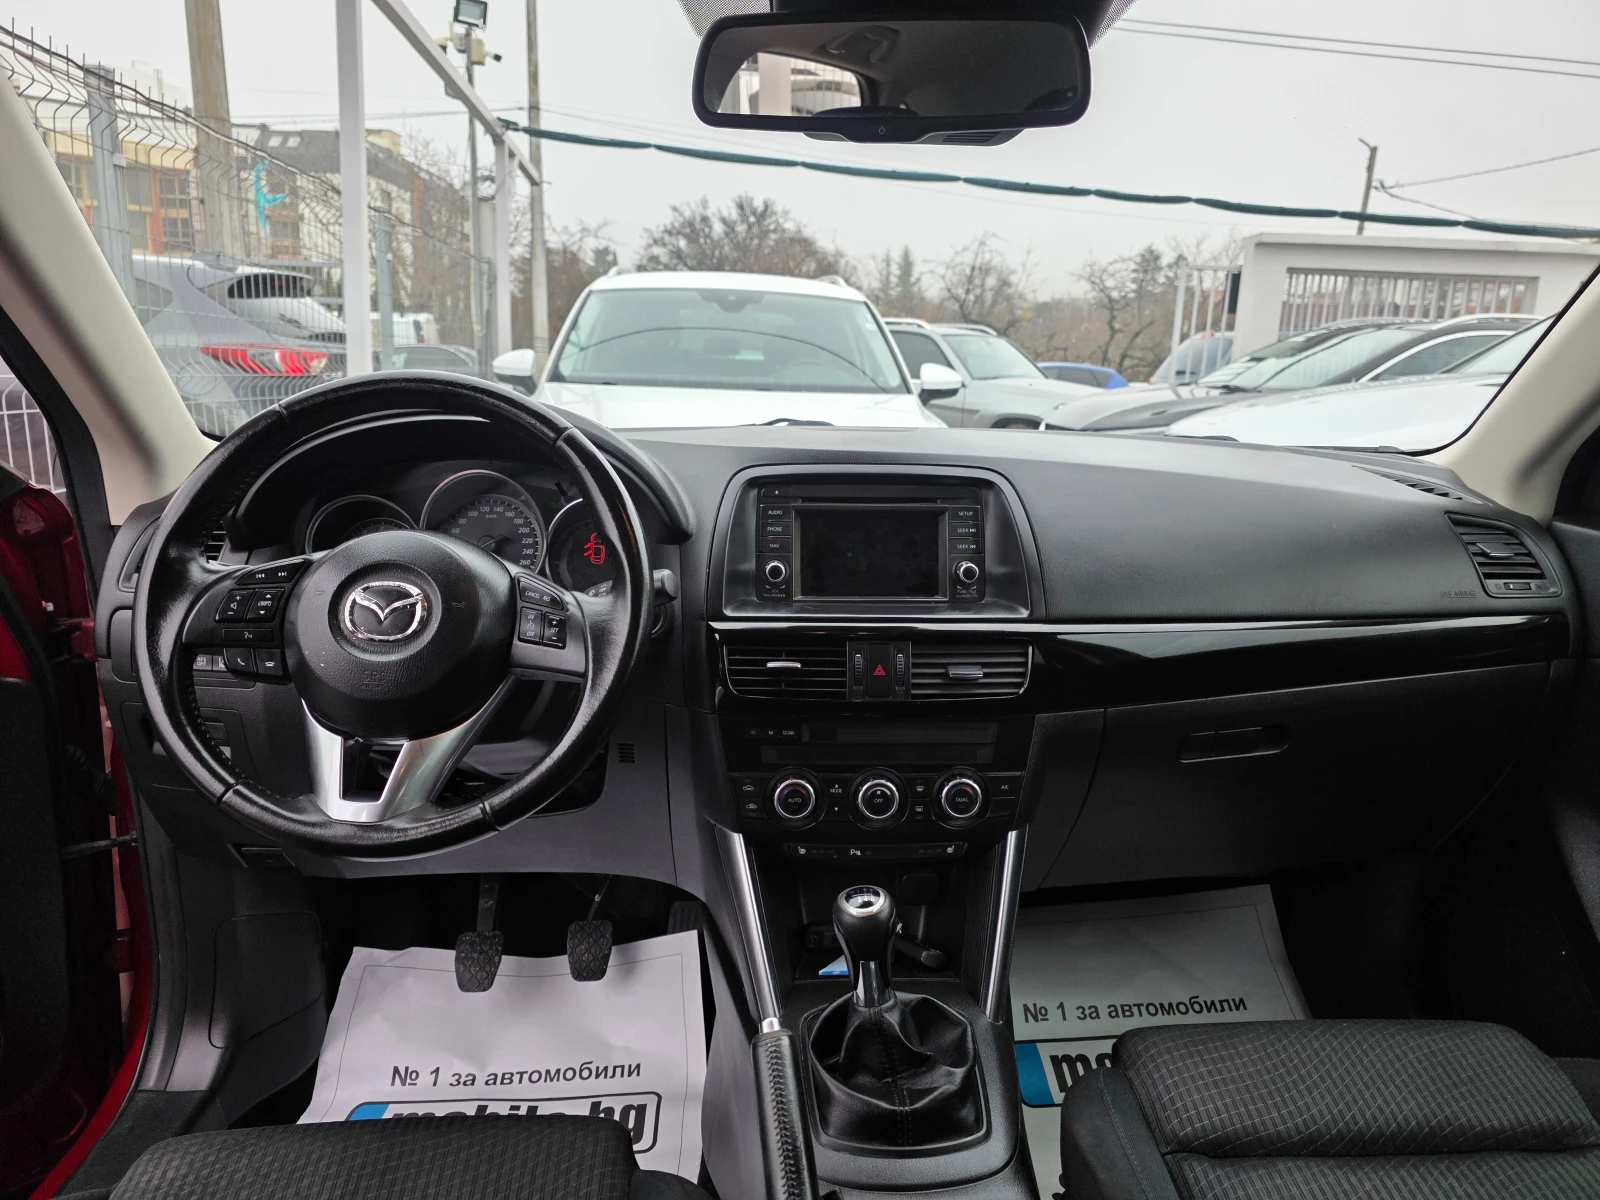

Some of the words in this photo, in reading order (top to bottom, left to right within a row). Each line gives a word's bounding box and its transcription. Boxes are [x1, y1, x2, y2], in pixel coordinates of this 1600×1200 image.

[525, 590, 540, 599] CANCEL
[1023, 1003, 1049, 1024] №
[1056, 1002, 1067, 1021] 1
[1076, 1005, 1101, 1021] за
[1107, 995, 1248, 1019] автомобили
[390, 1066, 420, 1087] №
[429, 1066, 441, 1087] 1
[448, 1072, 477, 1087] за
[484, 1061, 642, 1087] автомобили
